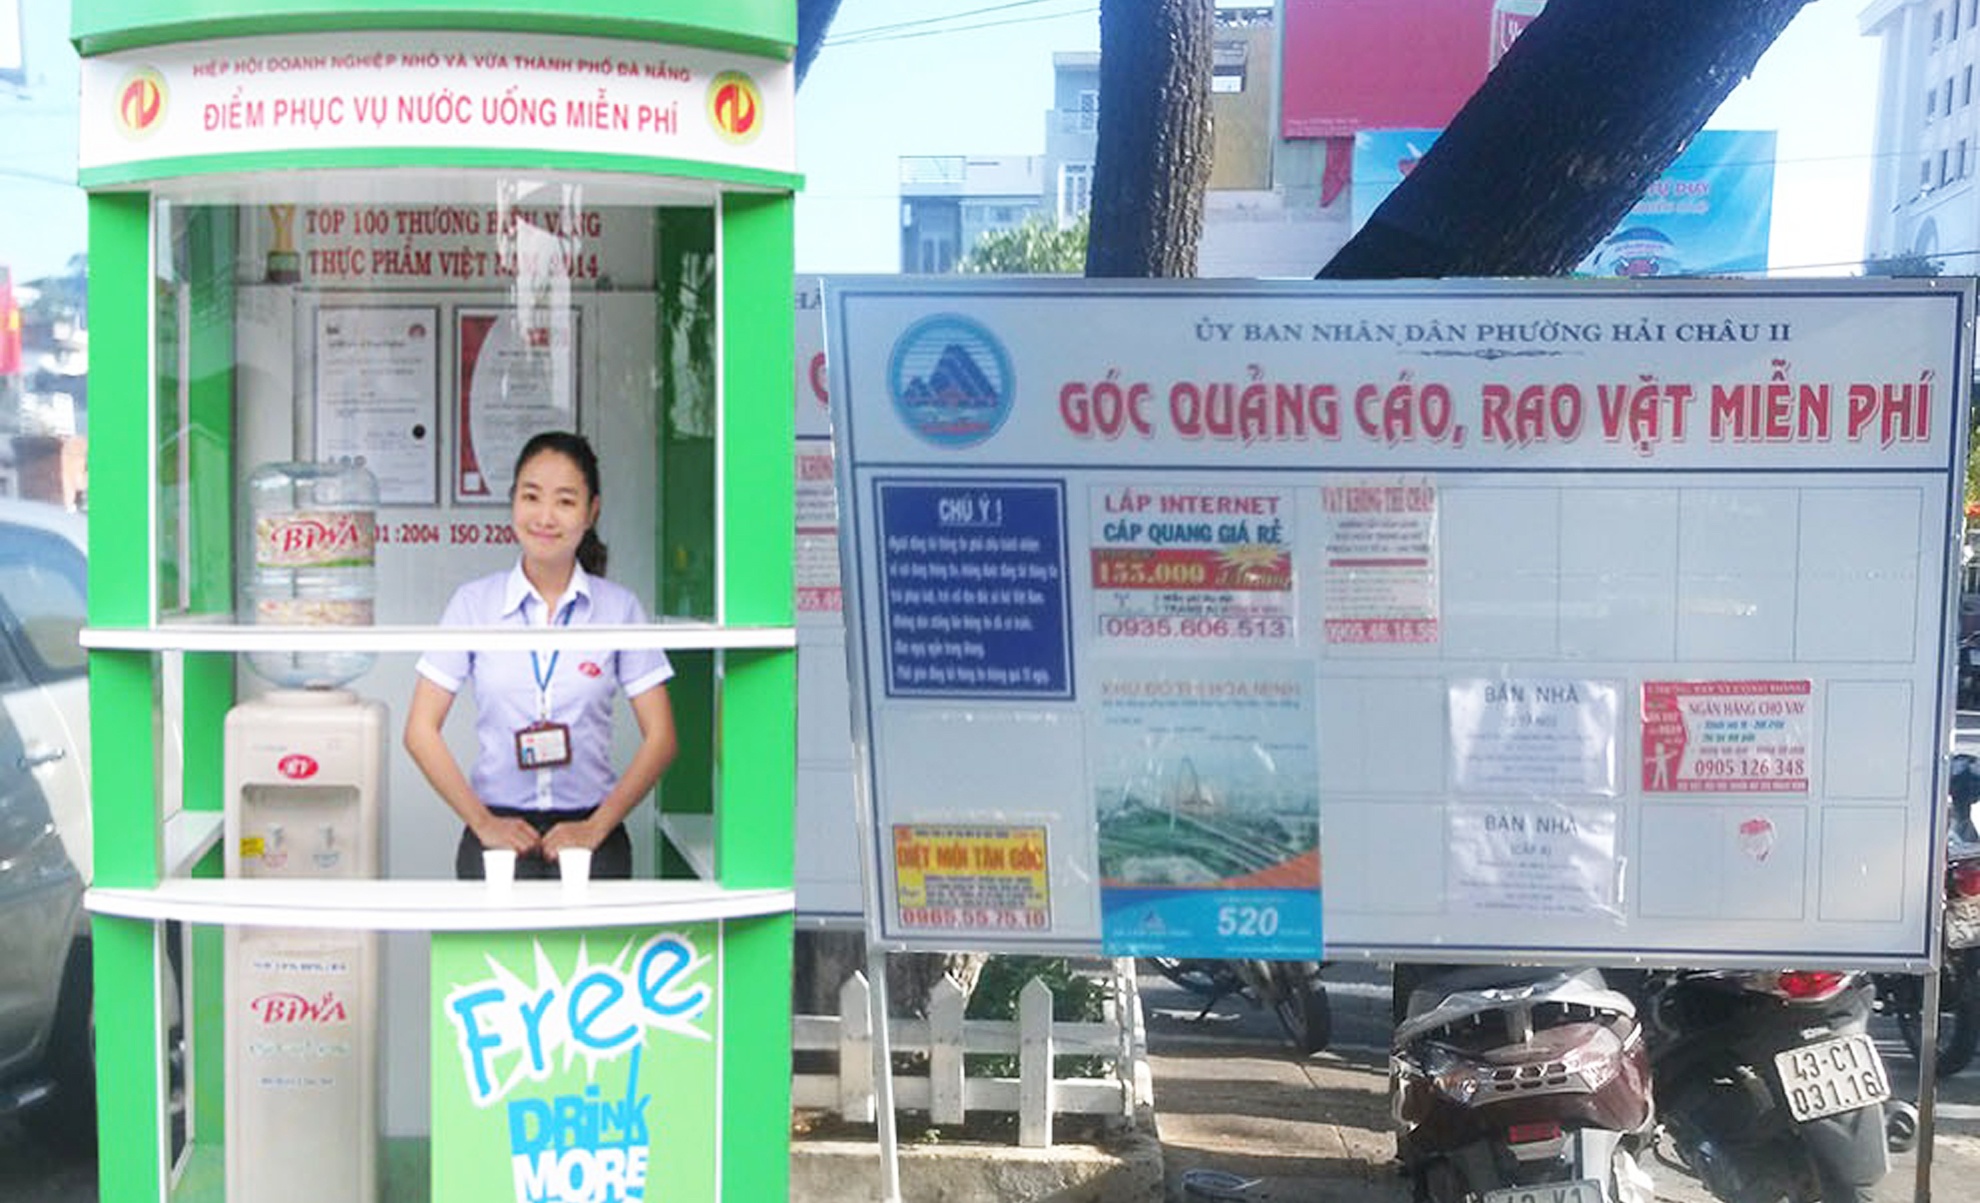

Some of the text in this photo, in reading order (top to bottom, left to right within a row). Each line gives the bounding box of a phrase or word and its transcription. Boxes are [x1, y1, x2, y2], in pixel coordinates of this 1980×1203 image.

[193, 60, 229, 77] HIỆP
[234, 55, 263, 75] HỘI
[267, 55, 327, 72] DOANH
[331, 53, 397, 70] NGHIỆP
[203, 84, 679, 135] ĐIỂM PHỤC VỤ NƯỚC UỐNG MIỄN PHÍ
[305, 210, 346, 234] TOP
[353, 210, 390, 234] 100
[396, 207, 480, 235] THƯƠNG
[308, 247, 364, 276] THỰC
[369, 236, 432, 276] PHẨM
[438, 247, 487, 281] VIỆT
[1243, 324, 1302, 341] BAN
[1311, 321, 1399, 342] NHÂN
[1406, 321, 1466, 343] DÂN
[1476, 320, 1602, 344] PHƯỜNG
[1612, 318, 1666, 343] HẢI
[1676, 318, 1759, 343] CHÂU
[1168, 363, 1342, 448] QUẢNG
[1481, 382, 1587, 450] RAO
[1596, 374, 1695, 457] VẶT
[1708, 358, 1840, 444] MIỄN
[1846, 370, 1936, 450] PHÍ
[937, 495, 973, 523] CHÚ
[1159, 495, 1281, 514] INTERNET
[450, 524, 480, 544] ISO
[1102, 519, 1143, 541] CÁP
[1148, 523, 1213, 545] QUANG
[1217, 519, 1249, 543] GIÁ
[1106, 617, 1286, 637] 0935.606.513
[1484, 683, 1579, 704] BÁN NHÀ
[1695, 758, 1804, 776] 0905 126 348
[1217, 906, 1279, 936] 520
[453, 939, 704, 1097] Free
[1792, 1042, 1858, 1081] 43-C1
[1793, 1071, 1881, 1115] 031.16
[512, 1146, 649, 1203] MORE
